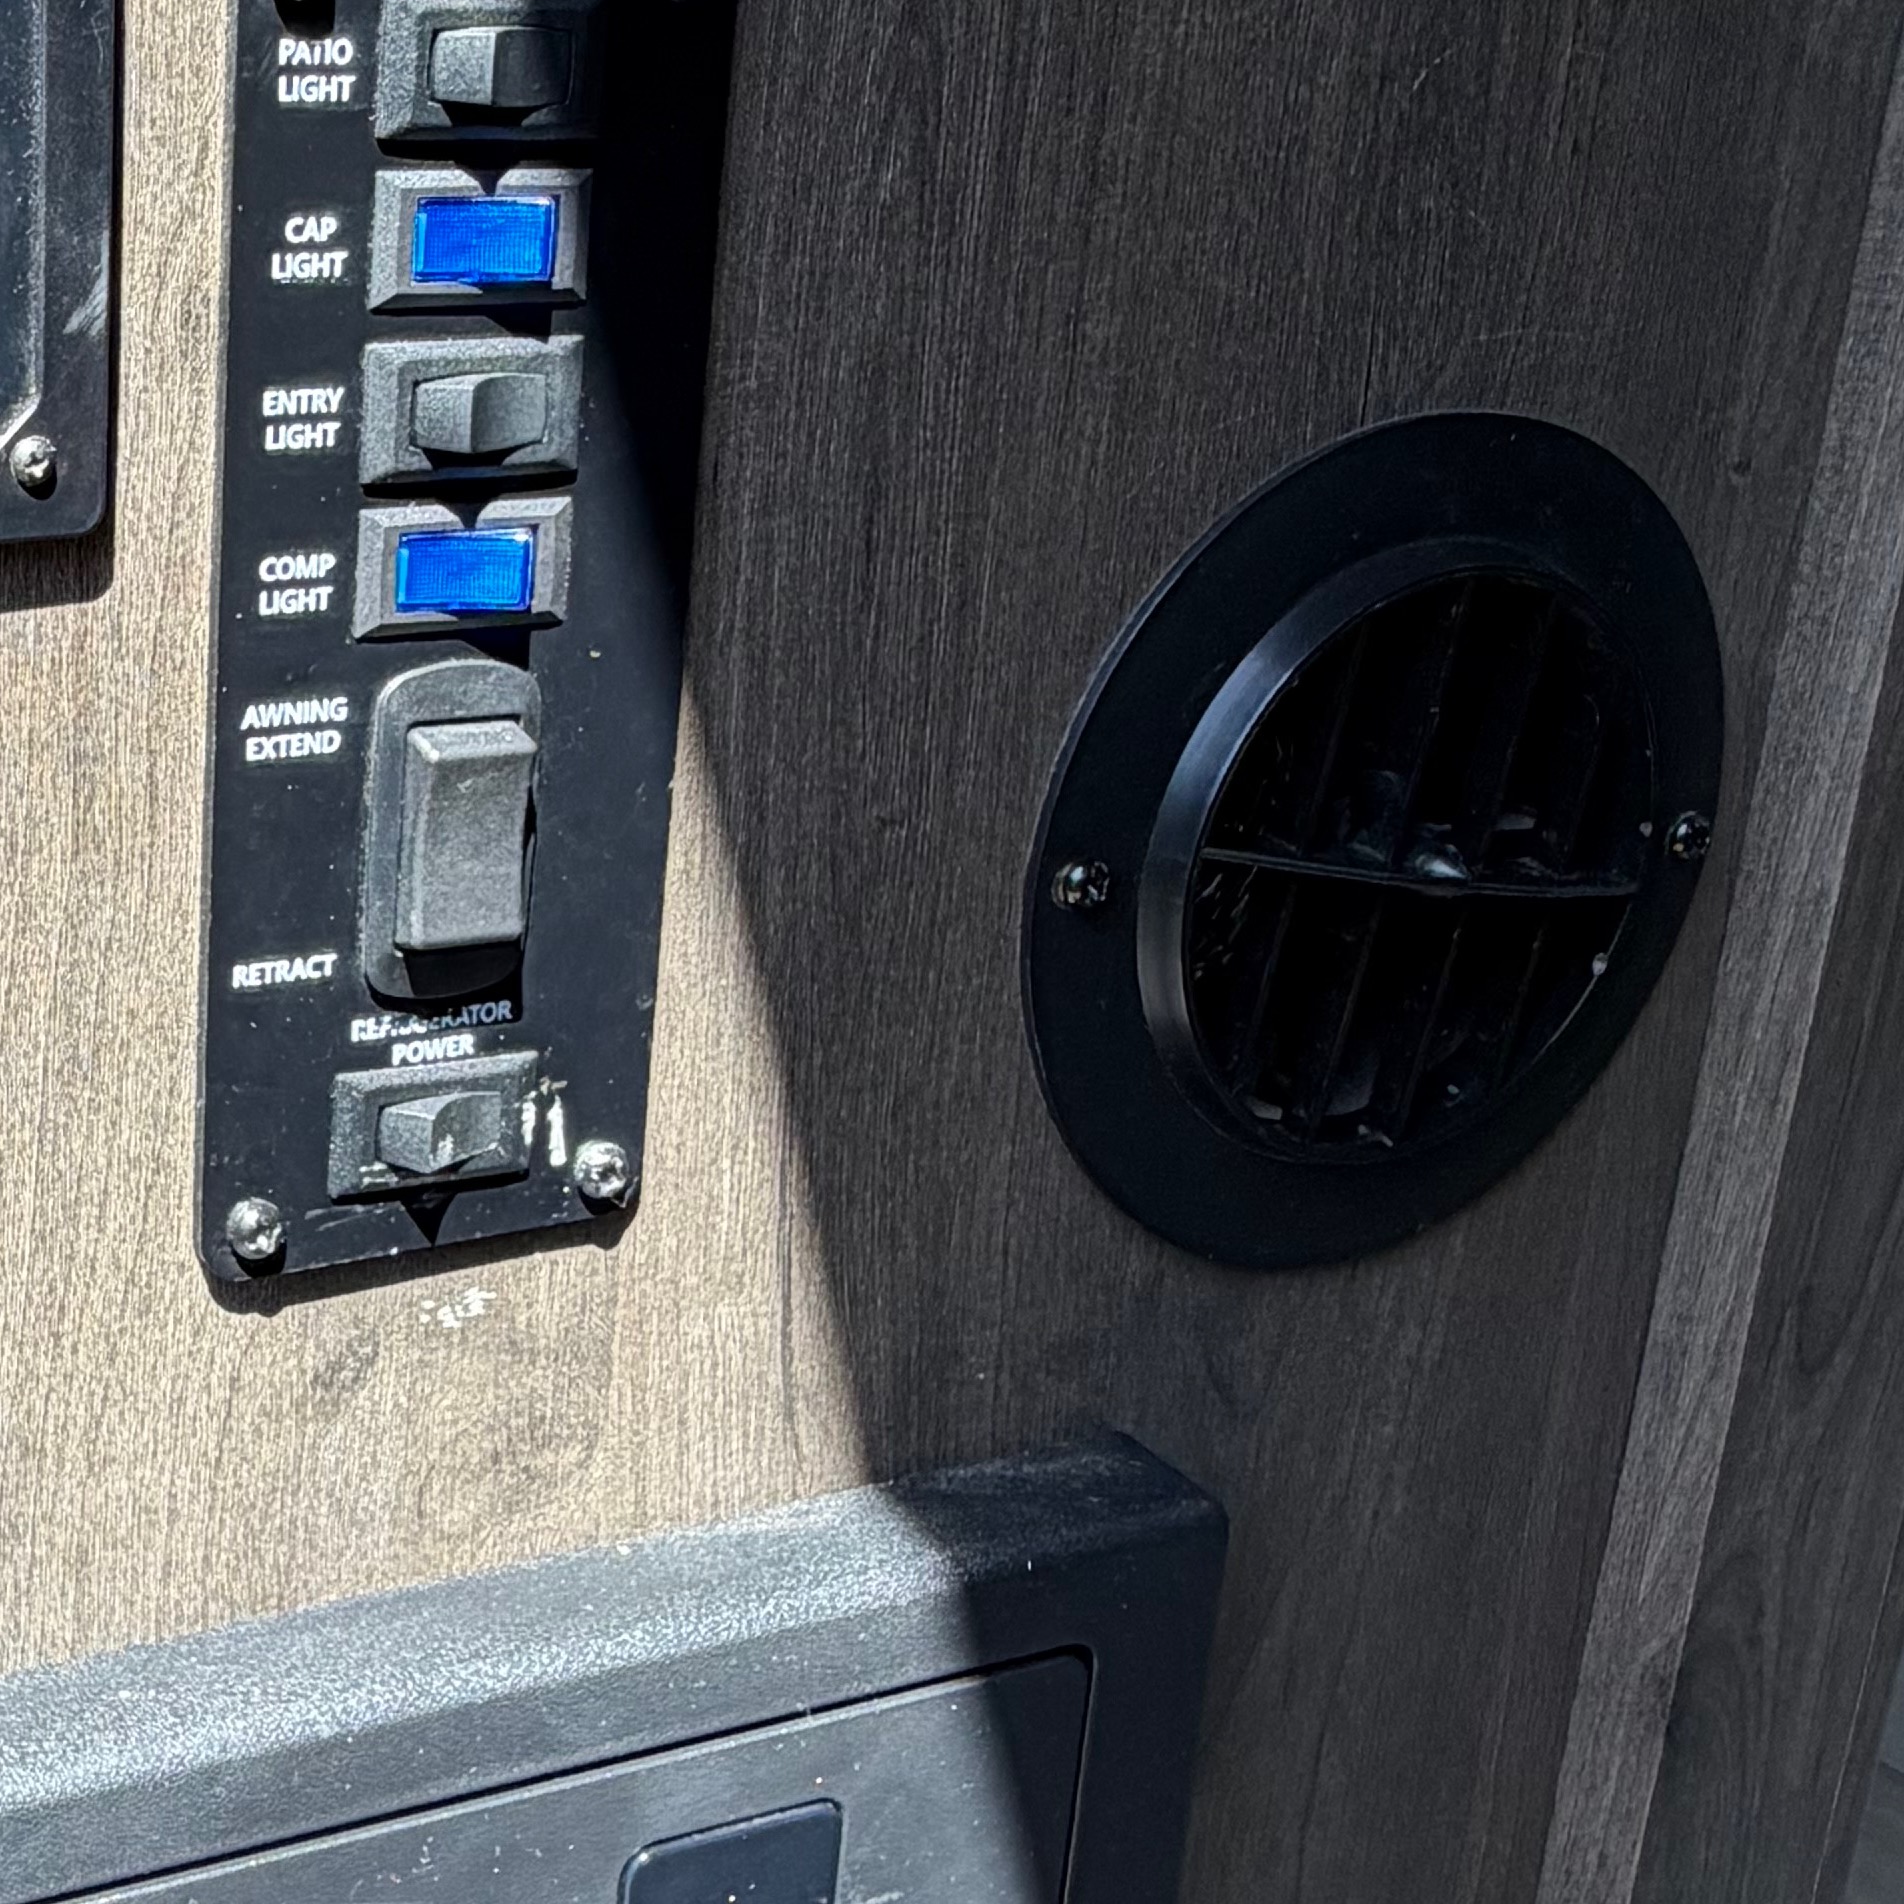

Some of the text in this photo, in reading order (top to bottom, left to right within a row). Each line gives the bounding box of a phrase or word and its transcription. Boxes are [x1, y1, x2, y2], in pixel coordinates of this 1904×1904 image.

[277, 37, 354, 67] PATIO
[278, 74, 357, 105] LIGHT
[284, 216, 338, 245] CAP
[270, 250, 348, 281] LIGHT
[262, 386, 345, 417] ENTRY
[264, 422, 341, 454] LIGHT
[258, 554, 336, 583] COMP
[258, 587, 333, 617] LIGHT
[240, 697, 349, 731] AWNING
[245, 729, 342, 762] EXTEND
[232, 952, 339, 989] RETRACT
[351, 1000, 514, 1043] REFGERATOR
[391, 1033, 476, 1067] POWER
